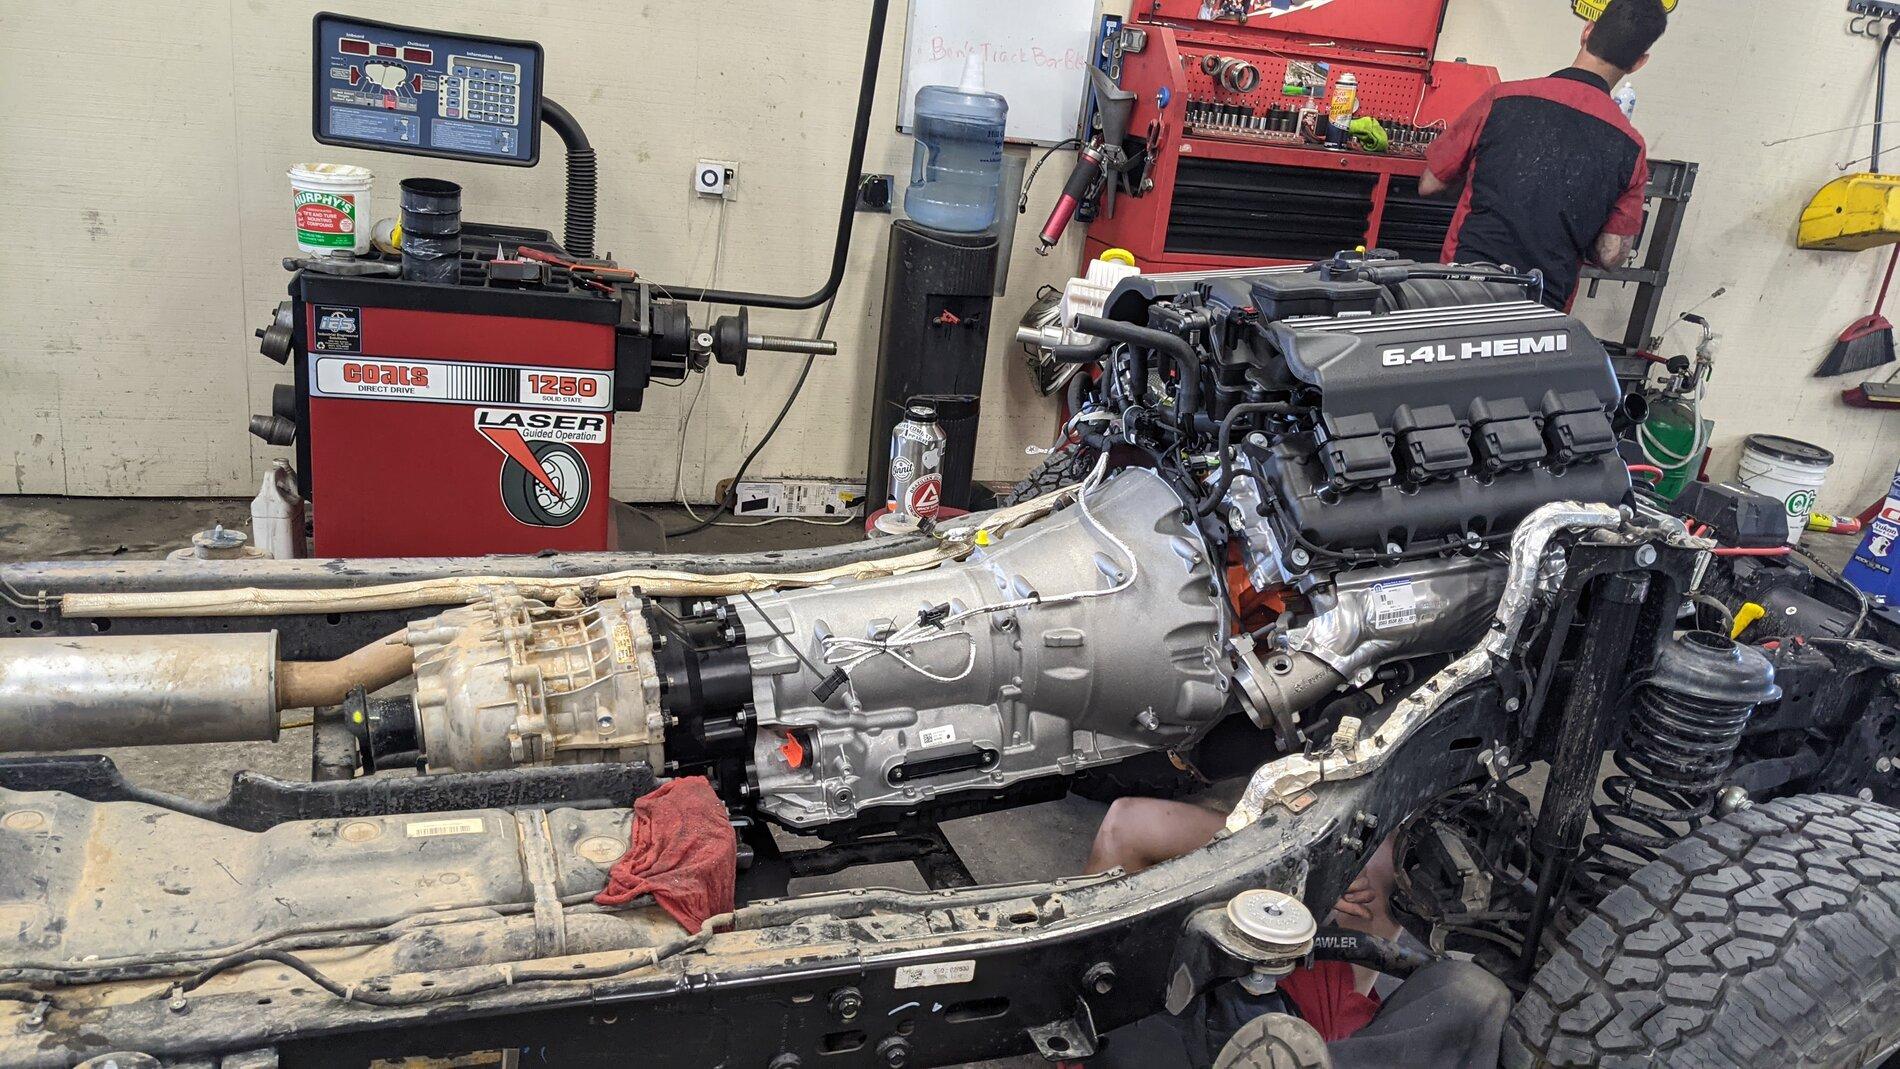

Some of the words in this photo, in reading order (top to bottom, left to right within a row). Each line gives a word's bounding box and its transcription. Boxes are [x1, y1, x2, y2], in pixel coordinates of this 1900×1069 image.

[466, 51, 493, 60] Information
[295, 192, 352, 214] MURPHY'S
[1382, 345, 1456, 367] 6.4L
[1460, 334, 1568, 360] HEMI
[358, 385, 388, 393] DIRECT
[390, 386, 415, 395] DRIVE
[528, 374, 597, 398] 1250
[562, 396, 582, 404] STATE
[478, 411, 604, 432] LASER
[522, 428, 553, 439] Guided
[555, 429, 597, 442] Operation
[1314, 936, 1358, 948] AWLER
